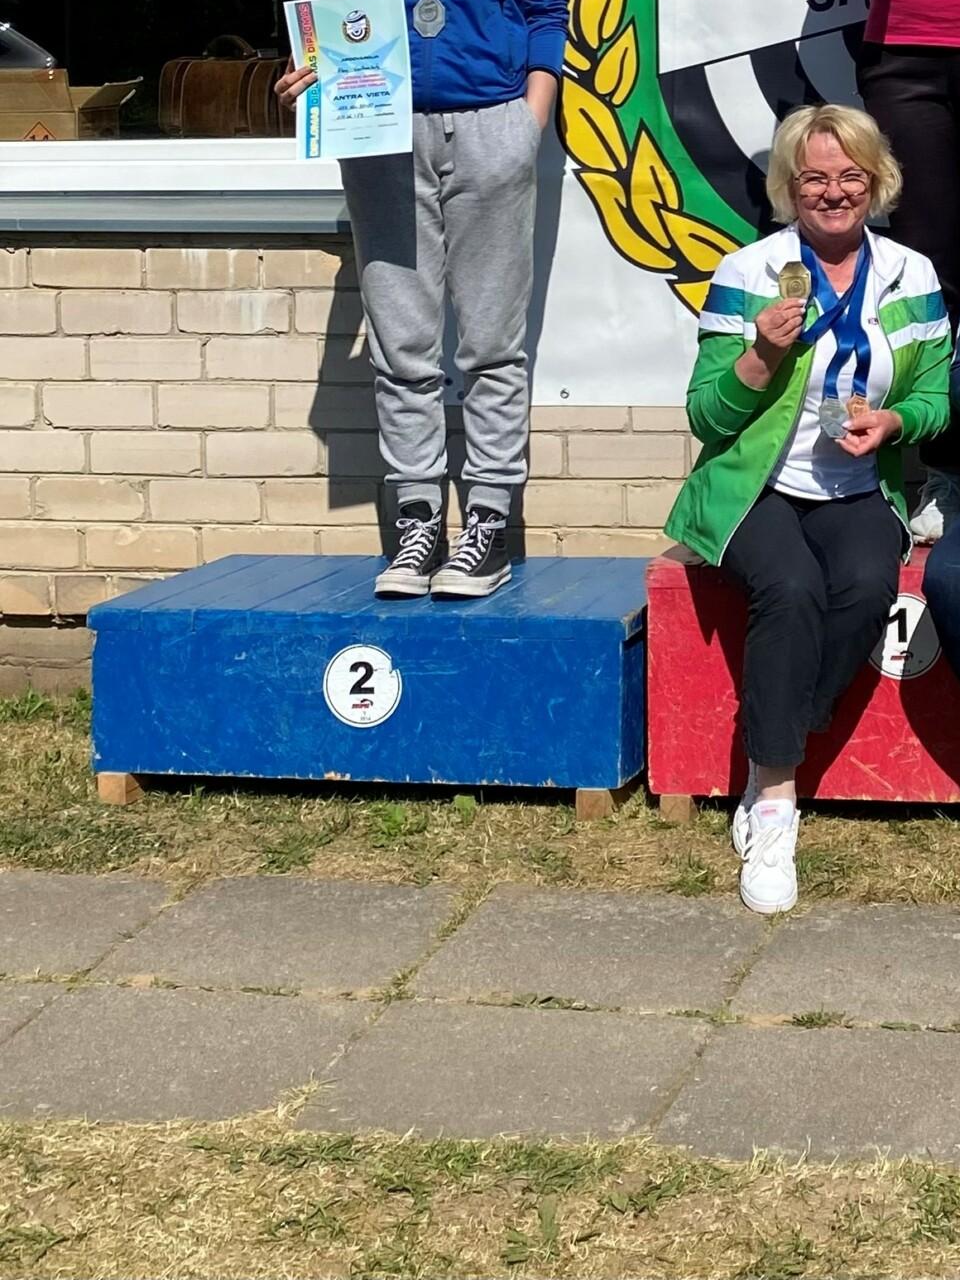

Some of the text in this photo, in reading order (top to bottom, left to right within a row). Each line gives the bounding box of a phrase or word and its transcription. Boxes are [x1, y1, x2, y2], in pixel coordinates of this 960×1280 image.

[333, 90, 391, 102] ANTRA VIETA
[887, 608, 908, 643] 1
[349, 661, 375, 695] 2
